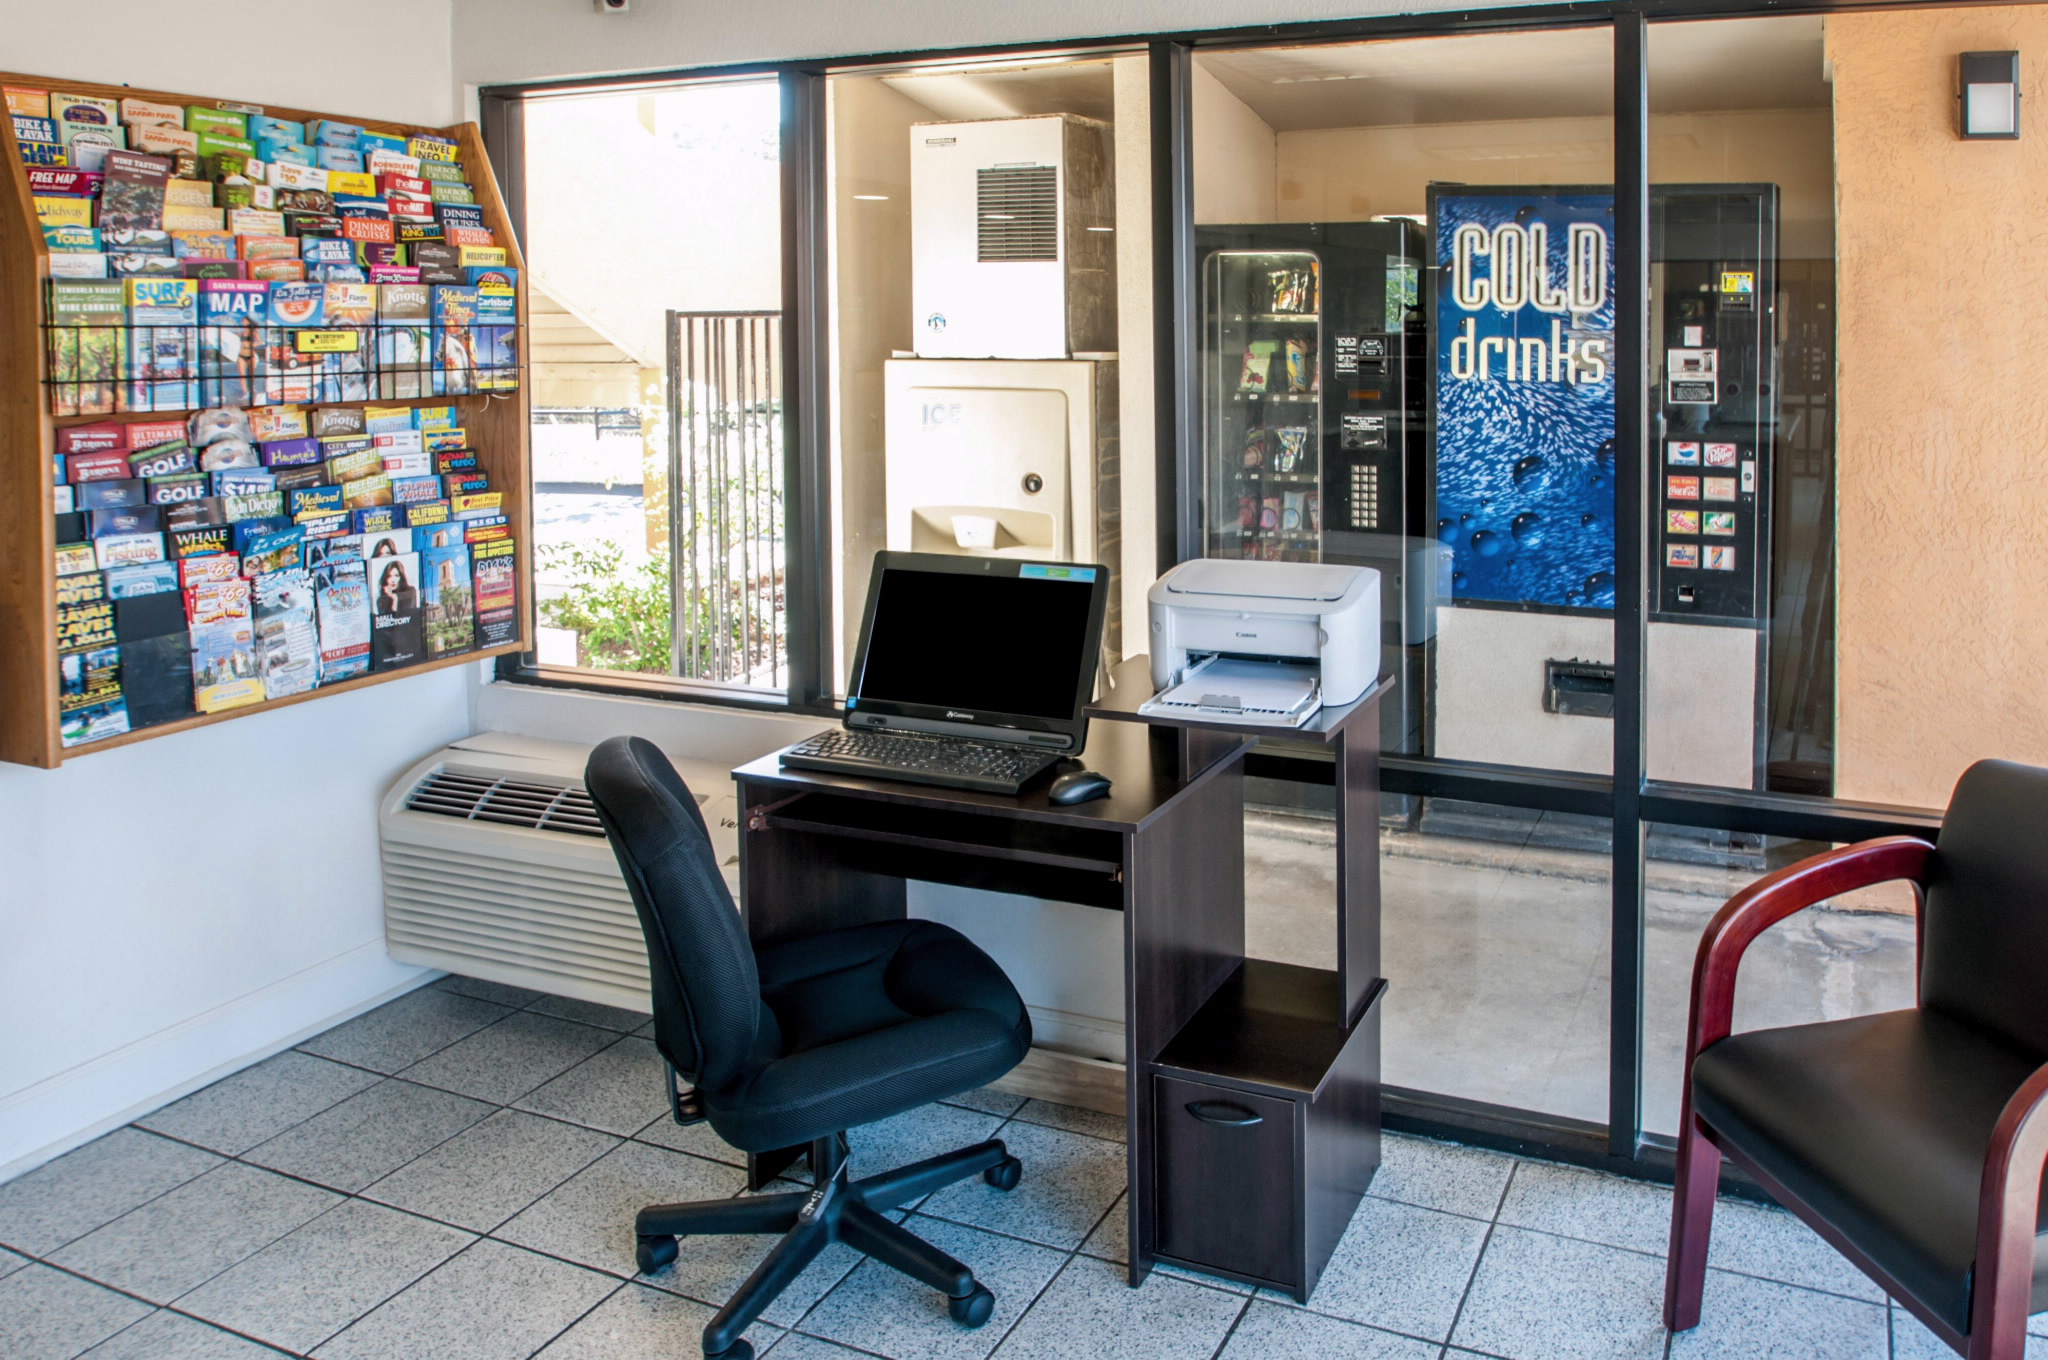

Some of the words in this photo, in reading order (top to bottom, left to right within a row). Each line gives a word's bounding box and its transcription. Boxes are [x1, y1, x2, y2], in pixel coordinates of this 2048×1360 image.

[14, 119, 41, 130] BIKE
[43, 120, 52, 130] &
[15, 128, 54, 142] KAYAK
[414, 140, 451, 155] TRAVEL
[415, 150, 441, 161] INFO
[112, 156, 133, 165] WINE
[135, 159, 167, 172] TASTING
[280, 165, 302, 176] Save
[426, 164, 457, 174] HARBOR
[30, 171, 54, 183] FREE
[55, 173, 78, 184] MAP
[426, 171, 460, 181] CRUISES
[169, 191, 211, 204] IGGEST
[436, 187, 468, 197] HARBOR
[436, 193, 469, 203] CRUISES
[38, 204, 84, 217] Midway
[443, 208, 480, 220] DINING
[349, 221, 390, 232] DINING
[401, 229, 424, 237] KING
[425, 227, 441, 236] TUT
[55, 234, 95, 245] TOURS
[348, 230, 390, 240] CRUISES
[457, 229, 483, 238] WHALE
[457, 236, 490, 244] DOLPHIN
[319, 241, 341, 251] BIKE
[320, 250, 351, 260] KAYAK
[466, 252, 505, 260] HELICOPTER
[1452, 222, 1608, 313] COLD
[135, 282, 186, 301] SURF
[349, 294, 368, 302] Flags
[387, 288, 426, 305] Knott's
[439, 288, 477, 303] Medieval
[210, 293, 264, 313] MAP
[446, 303, 471, 315] Times
[478, 298, 513, 307] Carlsbad
[1451, 317, 1606, 386] drinks
[321, 412, 361, 429] Knott's
[420, 407, 449, 421] SURF
[922, 403, 962, 425] ICE
[133, 430, 184, 440] ULTIMATE
[139, 453, 187, 478] GOLF
[451, 459, 476, 467] MUNDO
[451, 483, 462, 491] DEL
[463, 480, 488, 490] MUNDO
[157, 486, 205, 504] GOLF
[294, 490, 340, 509] Medieval
[230, 500, 248, 514] San
[249, 498, 278, 514] Diego
[408, 505, 448, 519] CALIFORNIA
[364, 514, 392, 526] WHALE
[243, 526, 268, 536] Fresh
[306, 523, 339, 536] RIDES
[176, 529, 228, 545] WHALE
[272, 533, 299, 546] OFF
[105, 545, 158, 562] Fishing
[179, 543, 225, 556] Watch
[57, 573, 103, 590] AYAK
[57, 587, 103, 605] AVES
[376, 614, 394, 622] MALL
[376, 616, 411, 629] DIRECTORY
[74, 630, 117, 647] JOLLA
[953, 711, 975, 721] Gateway
